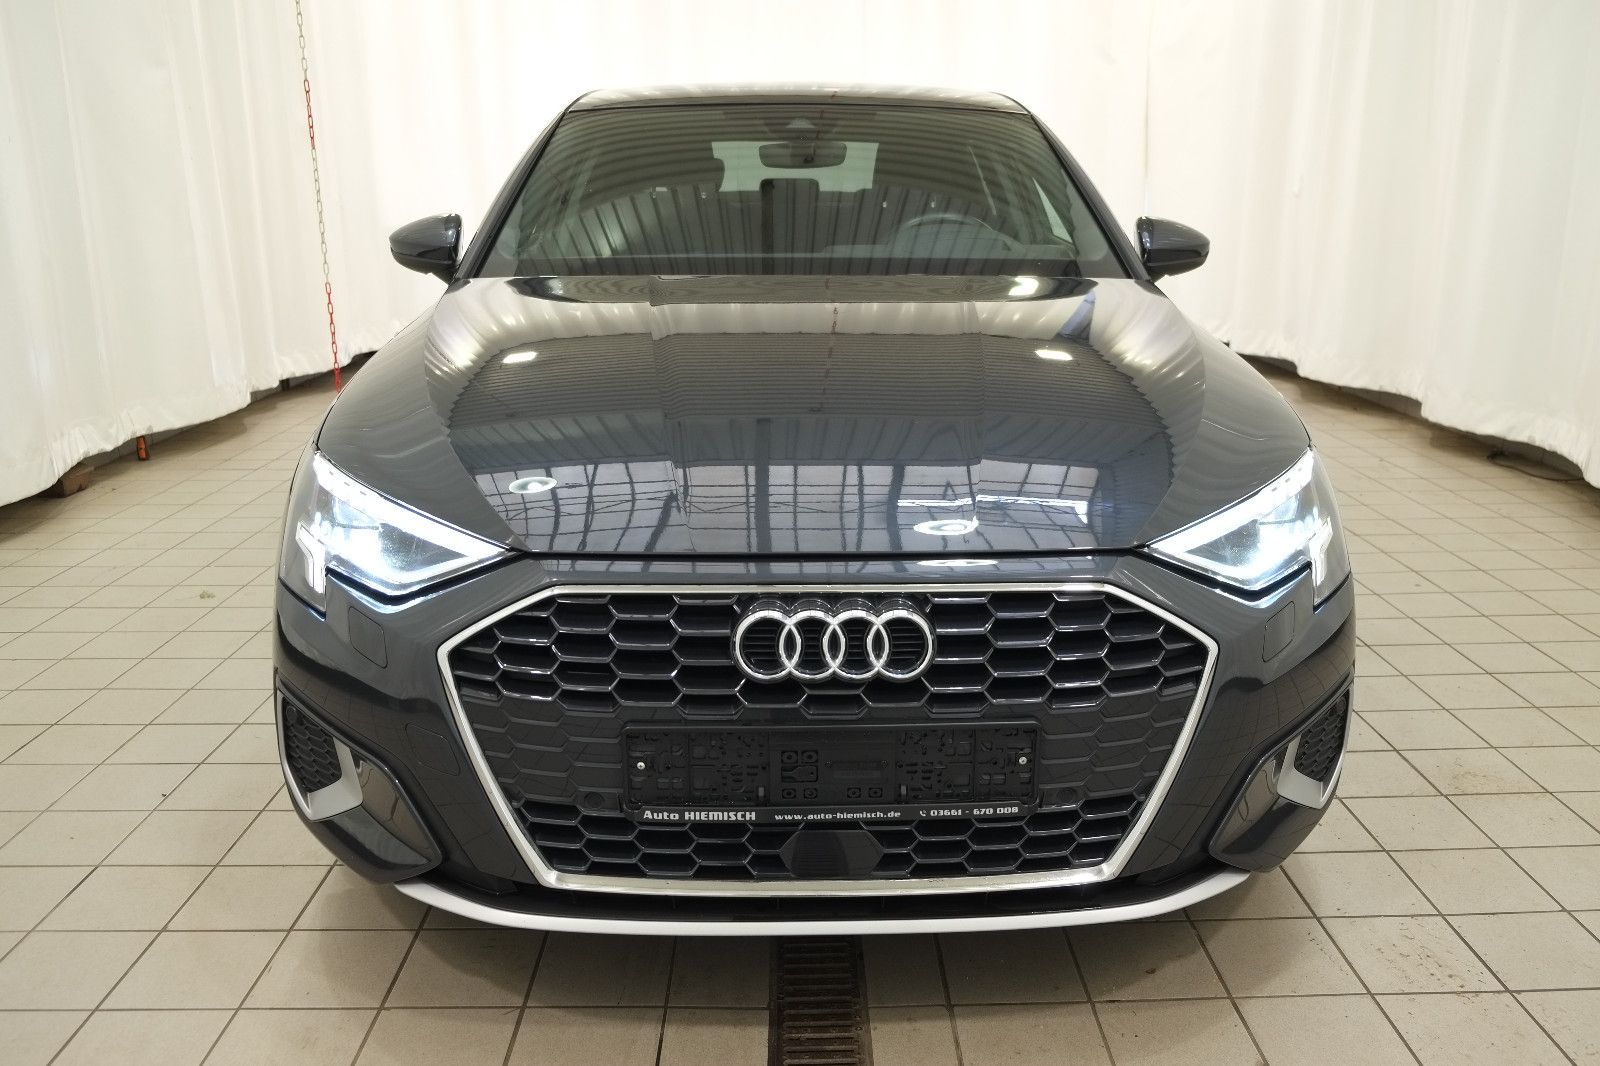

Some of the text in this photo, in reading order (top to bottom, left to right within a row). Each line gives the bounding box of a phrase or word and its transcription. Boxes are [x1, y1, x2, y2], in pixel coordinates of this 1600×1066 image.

[643, 810, 679, 820] Auto
[684, 811, 756, 821] HIEMISCH
[774, 811, 901, 820] www.auto-hiemisch.de
[929, 809, 962, 817] 03661
[973, 807, 994, 815] 670
[996, 806, 1019, 815] 008
